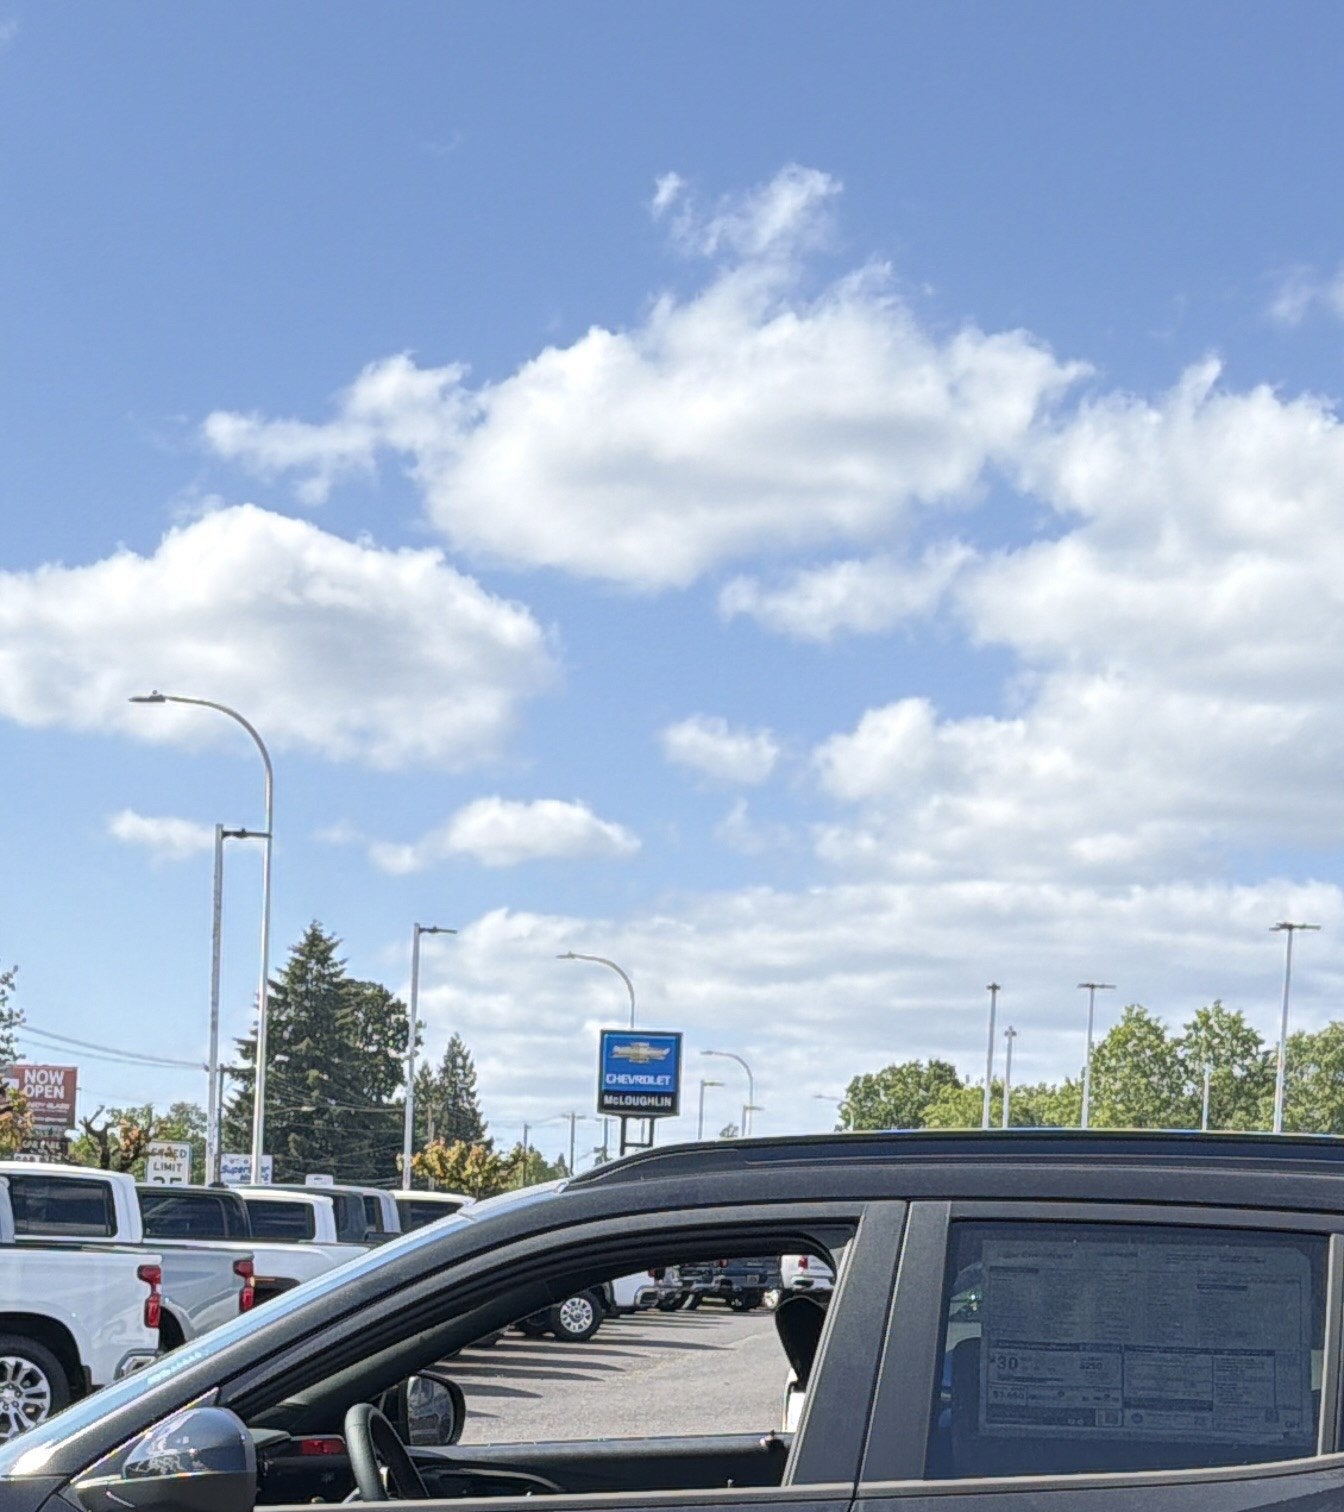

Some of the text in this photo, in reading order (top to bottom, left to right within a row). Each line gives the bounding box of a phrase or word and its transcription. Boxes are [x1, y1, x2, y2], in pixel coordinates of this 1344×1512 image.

[24, 1069, 64, 1085] NOW
[606, 1073, 671, 1085] CHEVROLET
[23, 1085, 64, 1099] OPEN
[603, 1095, 672, 1106] McLOUGHLIN
[153, 1162, 182, 1172] LIMIT
[997, 1355, 1018, 1370] 30
